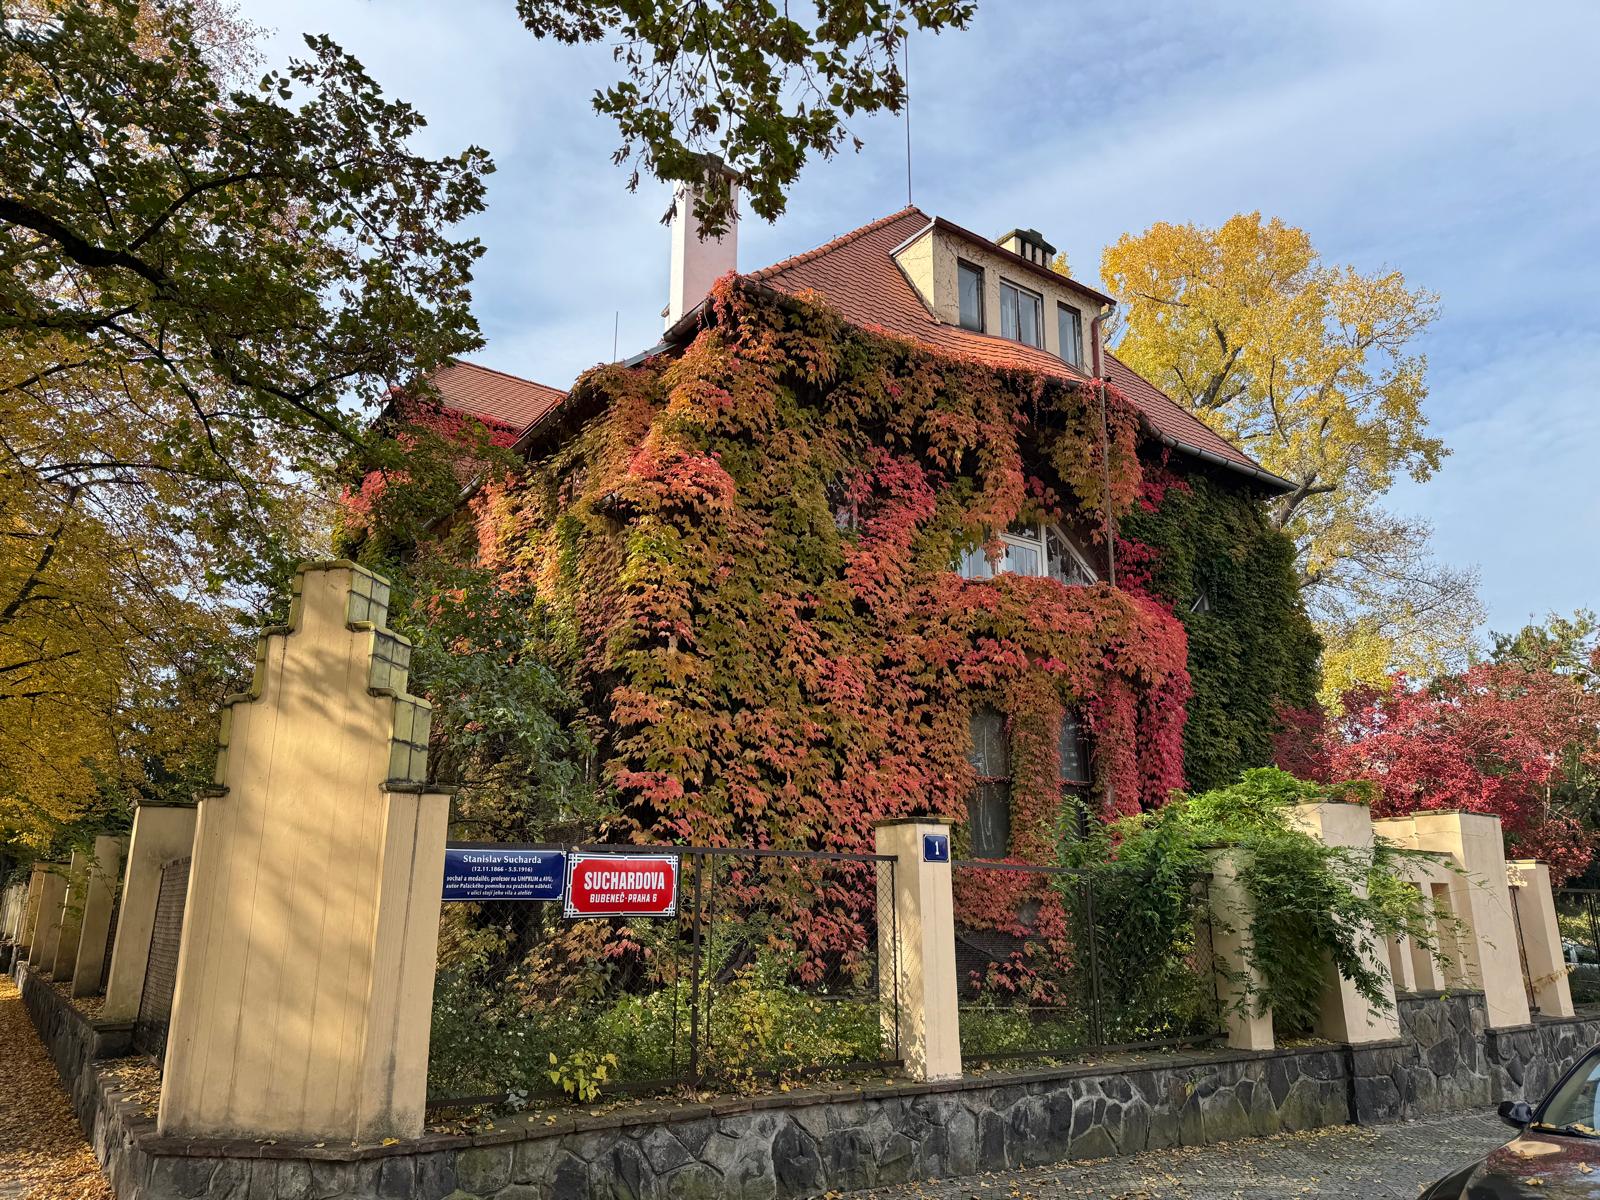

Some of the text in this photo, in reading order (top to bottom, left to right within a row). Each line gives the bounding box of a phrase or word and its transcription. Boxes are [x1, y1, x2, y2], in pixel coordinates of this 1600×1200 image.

[934, 840, 940, 856] 1
[463, 855, 542, 864] Stanislav Sucharda
[584, 872, 665, 890] SUCHARDOVA
[652, 894, 657, 902] 6
